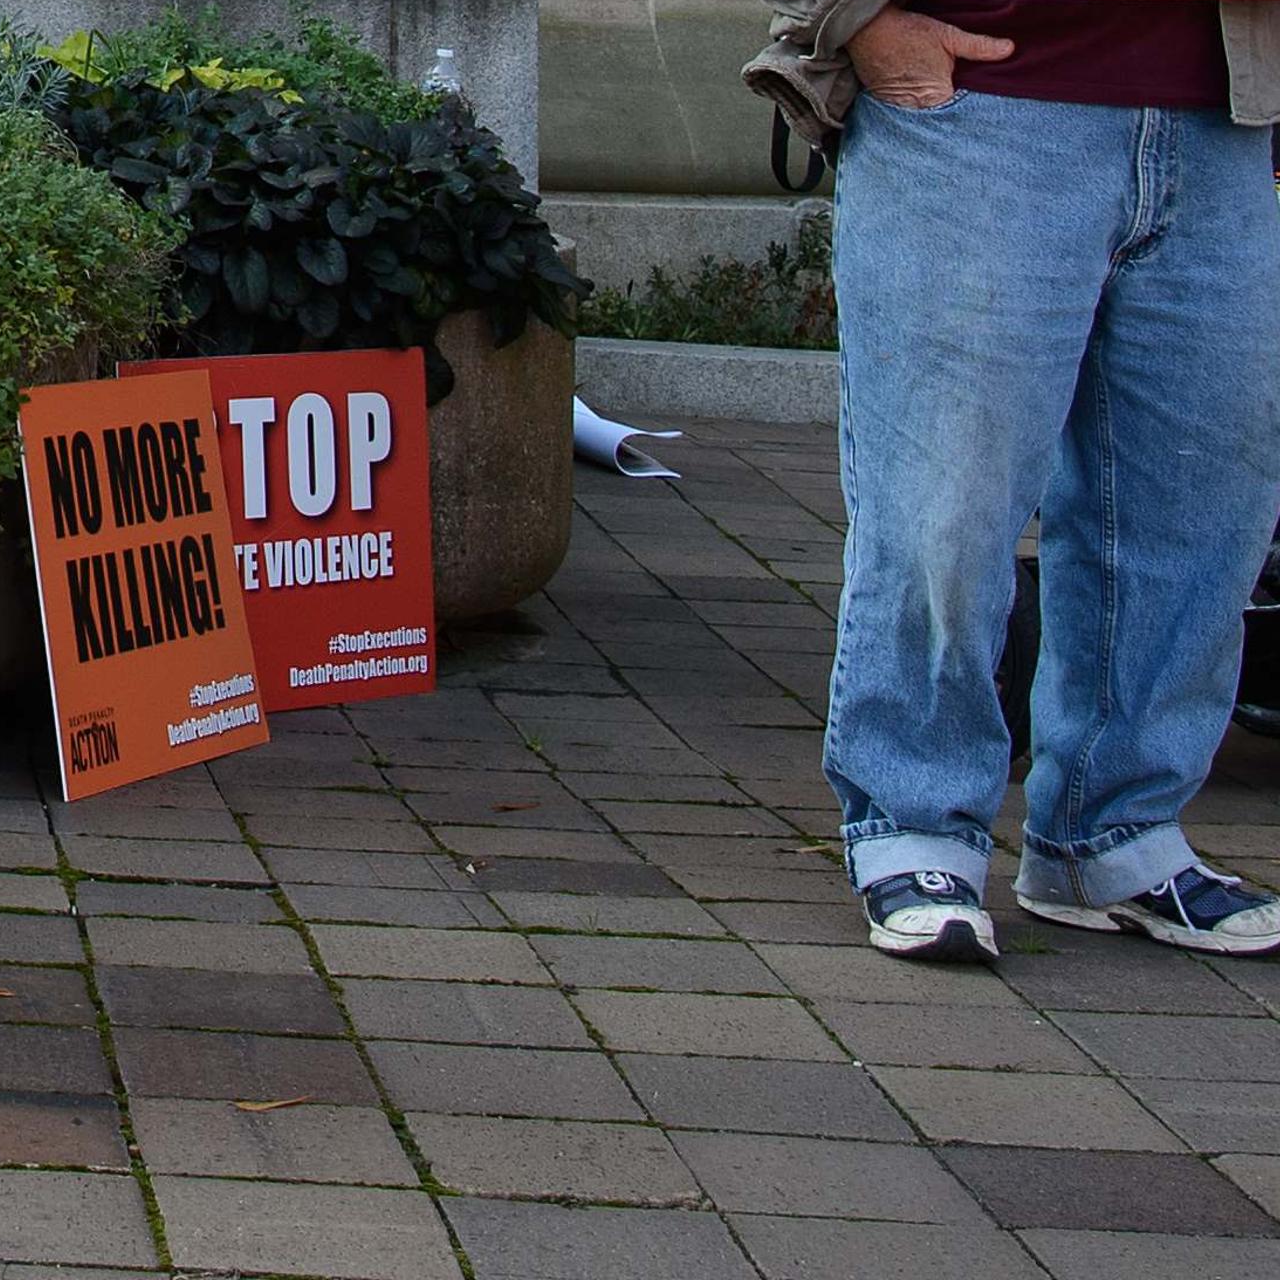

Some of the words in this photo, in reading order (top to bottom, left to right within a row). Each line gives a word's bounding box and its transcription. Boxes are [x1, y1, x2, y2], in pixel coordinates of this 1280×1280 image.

[43, 430, 103, 539] NO
[103, 417, 212, 528] MORE
[213, 392, 391, 520] TOP
[263, 531, 393, 588] VIOLENCE
[66, 533, 225, 664] KILLING!
[329, 625, 427, 655] #StopExecutions
[289, 655, 428, 688] DeathPenaltyAction.org
[70, 721, 120, 774] ACTION
